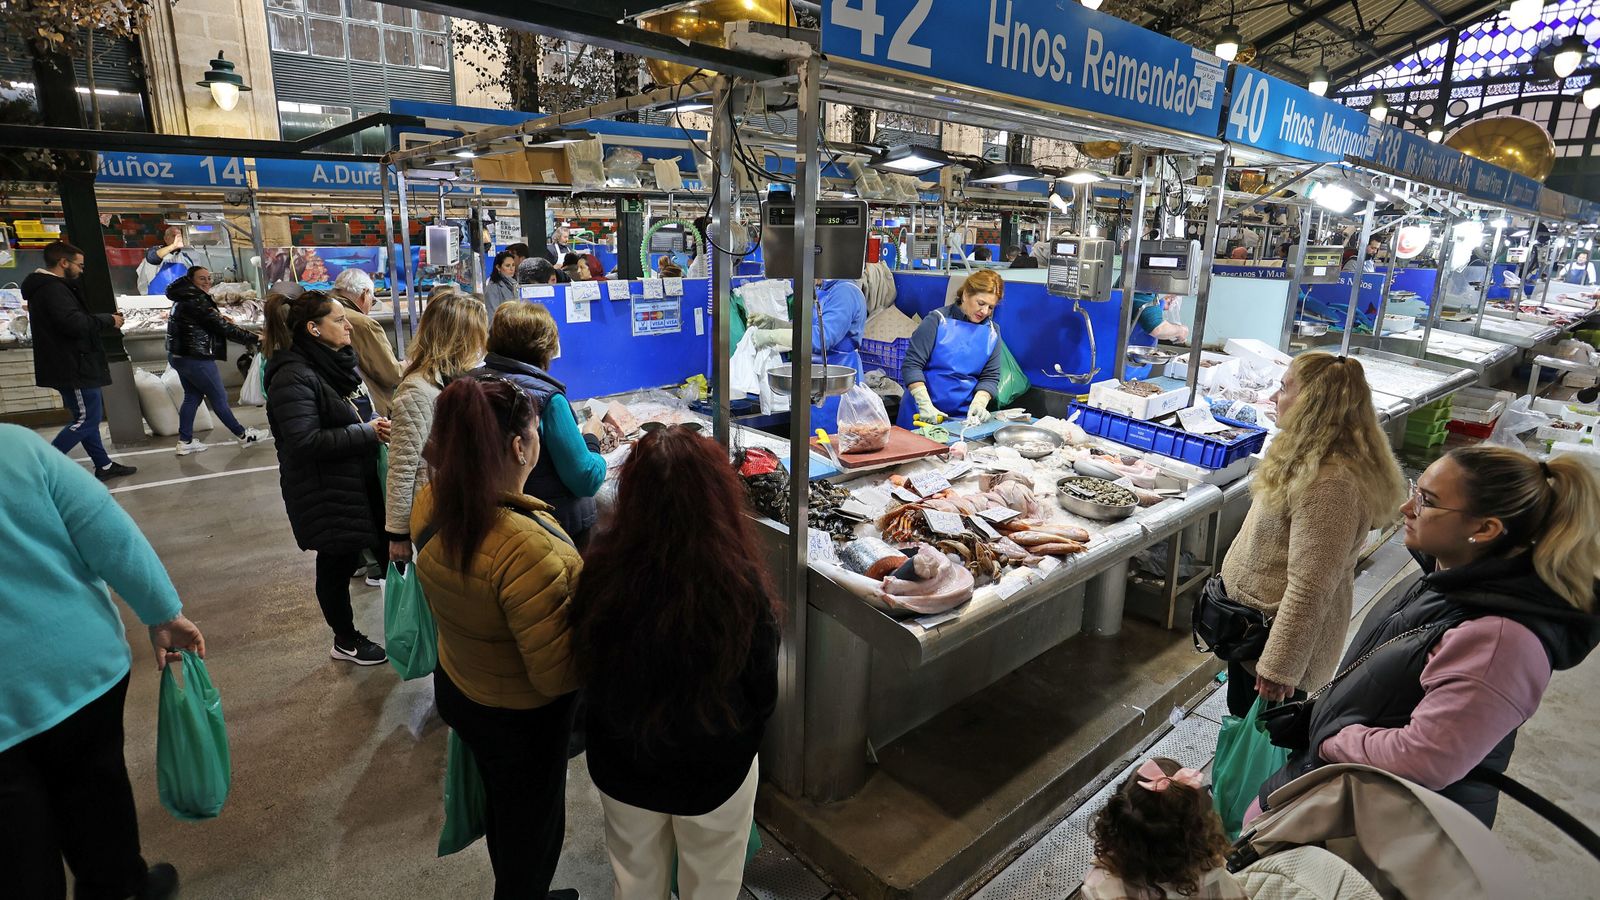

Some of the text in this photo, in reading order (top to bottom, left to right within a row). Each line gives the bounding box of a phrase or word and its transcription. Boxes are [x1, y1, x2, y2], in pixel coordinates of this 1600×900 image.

[831, 0, 1199, 116] 42 Hnos. Remendao
[1230, 73, 1269, 144] 40
[1279, 98, 1314, 148] Hnos.
[1384, 129, 1402, 169] 38
[200, 156, 244, 185] 14
[1461, 156, 1473, 189] 36
[1258, 270, 1264, 278] Y
[1266, 270, 1285, 278] MAR
